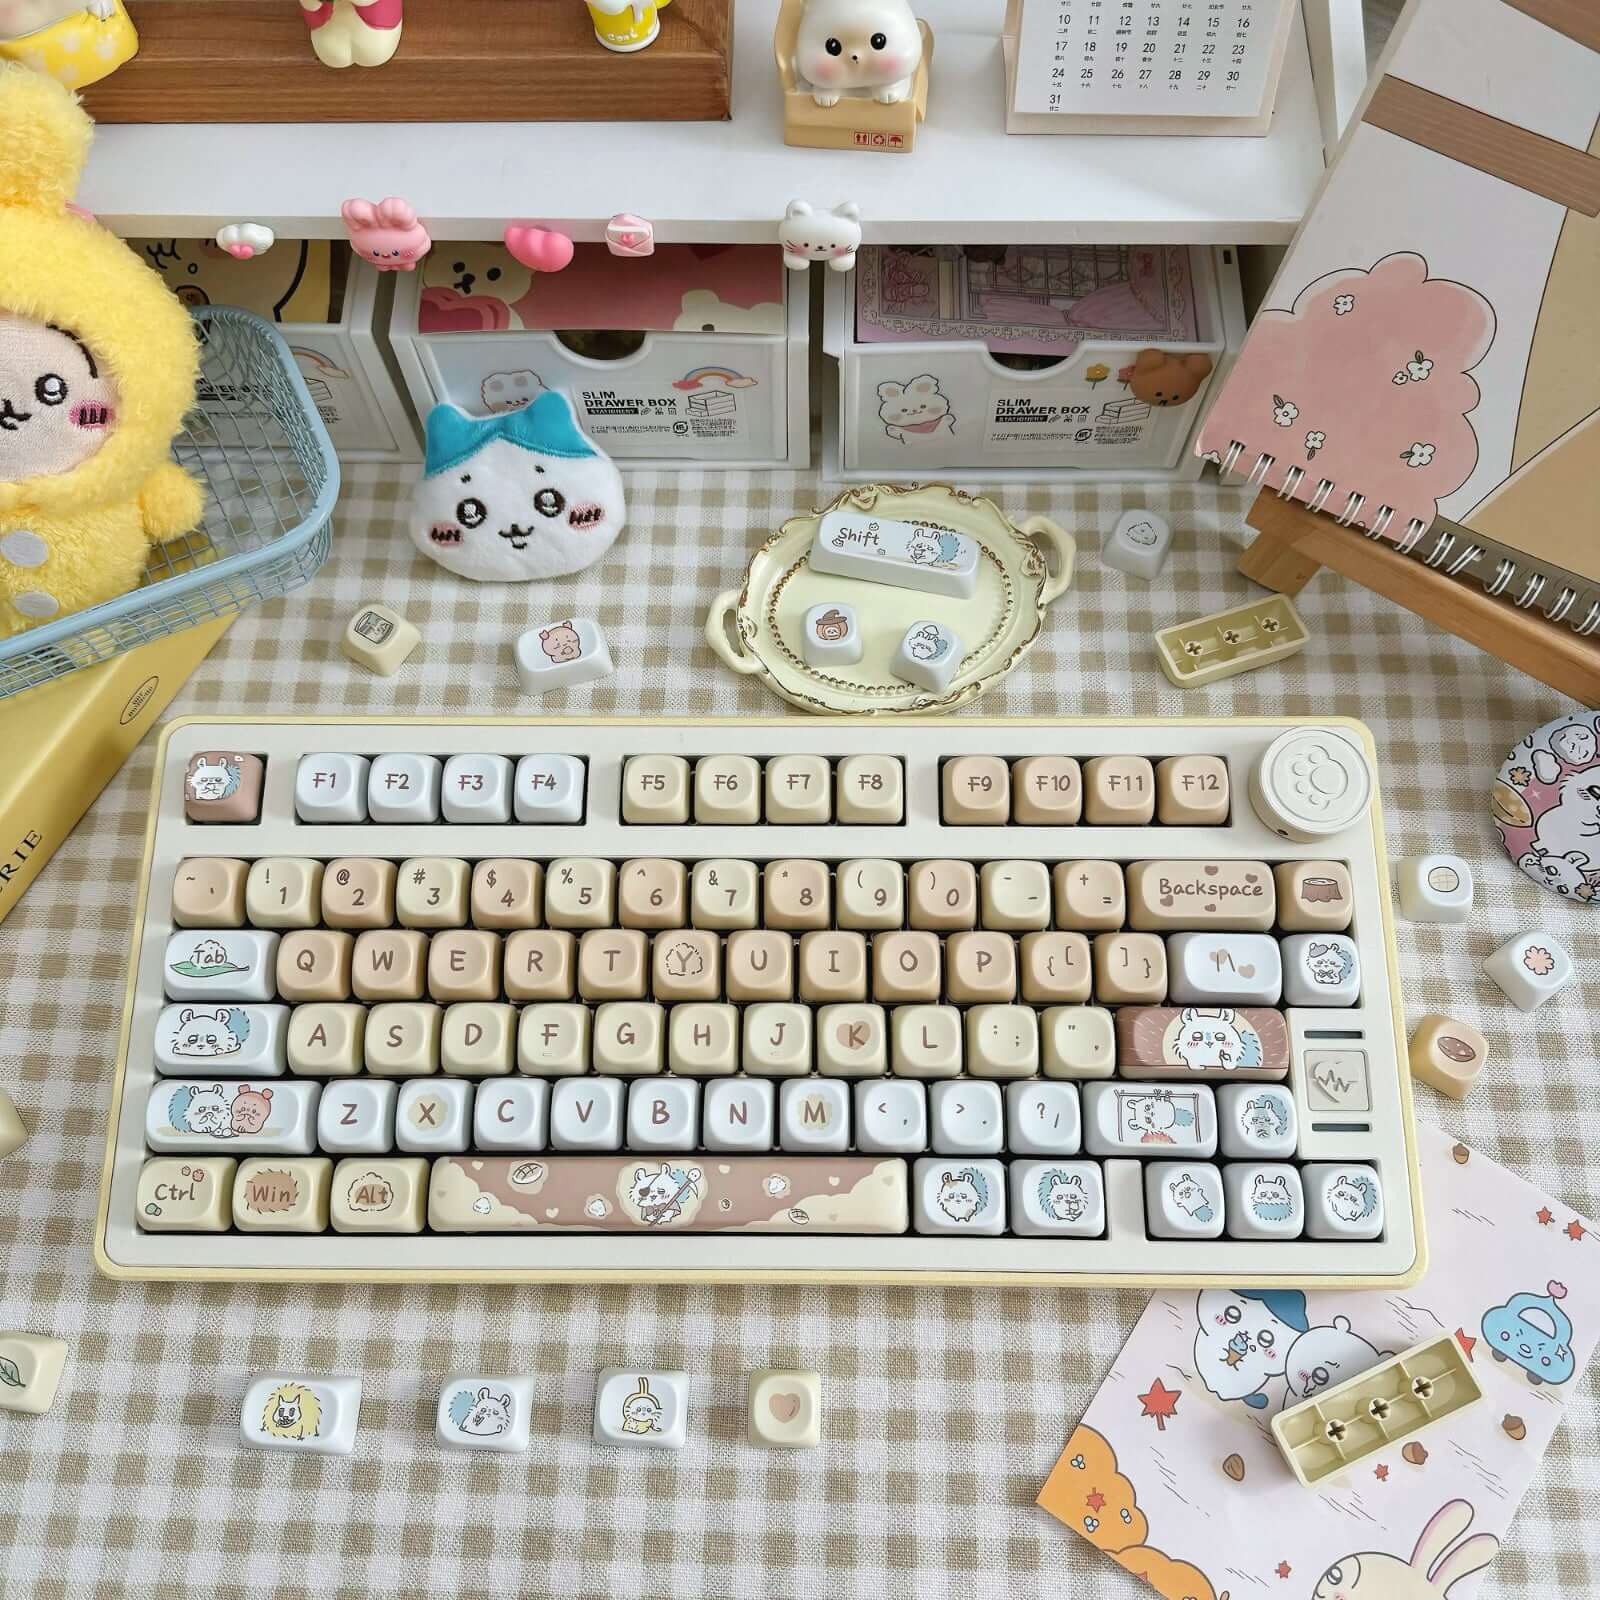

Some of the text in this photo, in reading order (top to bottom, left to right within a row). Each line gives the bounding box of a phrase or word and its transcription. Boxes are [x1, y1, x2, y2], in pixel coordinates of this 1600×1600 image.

[1059, 14, 1250, 28] 10 11 12 13 14 15 16
[1056, 41, 1245, 55] 17 18 19 20 21 22 23
[1052, 68, 1240, 81] 24 25 26 27 28 29 30
[1049, 94, 1061, 104] 31
[582, 391, 616, 399] SLIM
[584, 398, 677, 407] DRAWER BOX
[997, 399, 1031, 407] SLIM
[996, 406, 1091, 415] DRAWER BOX
[839, 527, 880, 547] Shift
[313, 773, 1219, 792] F1 F2 F3 F4 F5 F6 F7 F8 F9 F10 F11 F12
[266, 869, 269, 884] !
[336, 869, 350, 885] @
[413, 868, 425, 884] #
[487, 869, 496, 888] $
[562, 868, 573, 884] %
[709, 870, 718, 886] &
[858, 870, 863, 888] (
[930, 872, 935, 890] )
[1080, 874, 1088, 886] +
[280, 887, 286, 904] 1
[352, 889, 364, 905] 2
[427, 888, 440, 905] 3
[501, 889, 514, 907] 4
[579, 888, 592, 904] 5
[650, 888, 663, 906] 6
[725, 890, 736, 906] 7
[800, 888, 813, 906] 8
[875, 889, 886, 906] 9
[947, 889, 959, 906] 0
[1159, 878, 1264, 900] Backspace
[193, 949, 225, 965] Tab
[297, 949, 315, 972] Q
[372, 950, 393, 971] W
[451, 950, 466, 971] E
[528, 950, 543, 972] R
[603, 950, 621, 971] T
[676, 950, 693, 973] Y
[751, 950, 767, 971] U
[829, 950, 840, 972] I
[900, 950, 918, 972] O
[976, 951, 992, 972] P
[308, 1024, 326, 1047] A
[387, 1025, 403, 1047] S
[465, 1023, 482, 1046] D
[541, 1024, 560, 1046] F
[617, 1022, 635, 1044] G
[694, 1024, 710, 1046] H
[770, 1023, 786, 1046] J
[848, 1024, 865, 1048] K
[923, 1026, 938, 1048] L
[340, 1104, 357, 1125] Z
[419, 1103, 435, 1125] X
[498, 1099, 514, 1122] C
[576, 1100, 593, 1123] V
[652, 1100, 670, 1124] B
[730, 1101, 747, 1125] N
[804, 1101, 826, 1123] M
[1037, 1103, 1045, 1119] ?
[154, 1182, 388, 1204] Ctrl Win Alt
